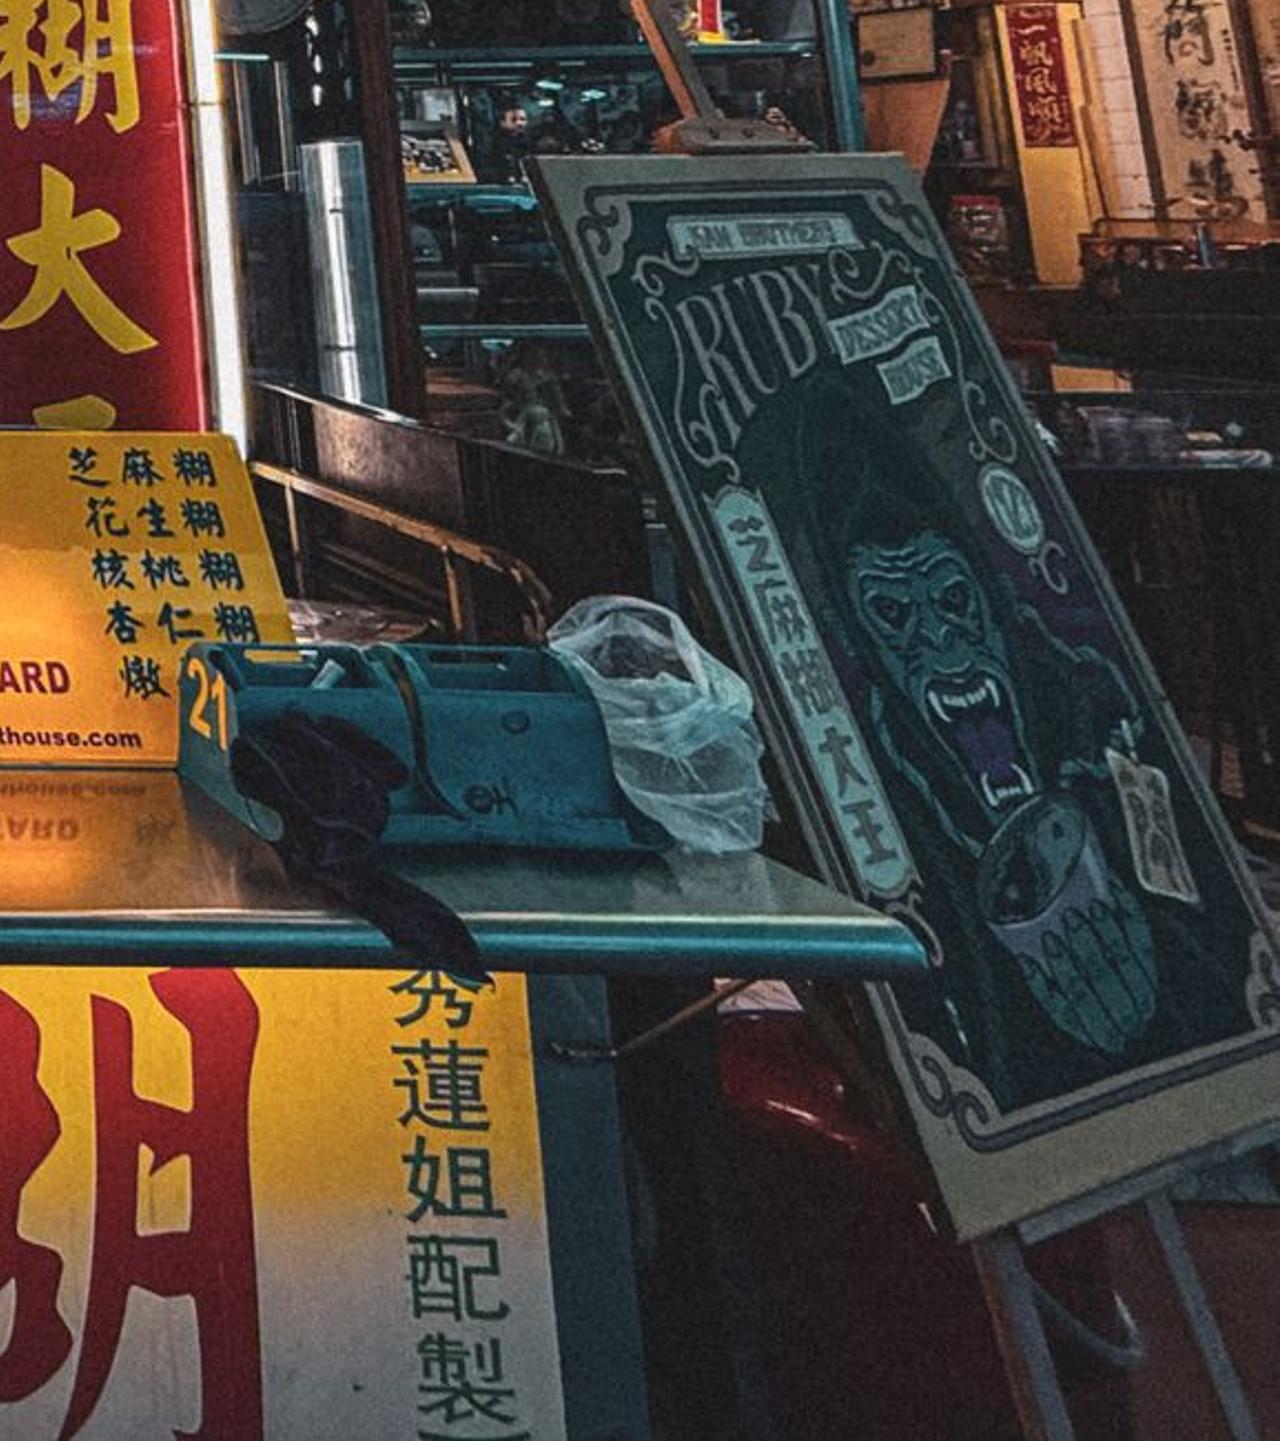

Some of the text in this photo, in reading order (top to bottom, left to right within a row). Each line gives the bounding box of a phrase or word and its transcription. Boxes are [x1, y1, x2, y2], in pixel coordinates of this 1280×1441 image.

[676, 263, 837, 418] RUBY
[68, 446, 217, 488] 芝麻糊
[84, 495, 226, 538] 花生糊
[91, 548, 245, 591] 核桃糊
[104, 599, 261, 645] 杏仁糊
[186, 657, 228, 752] 21
